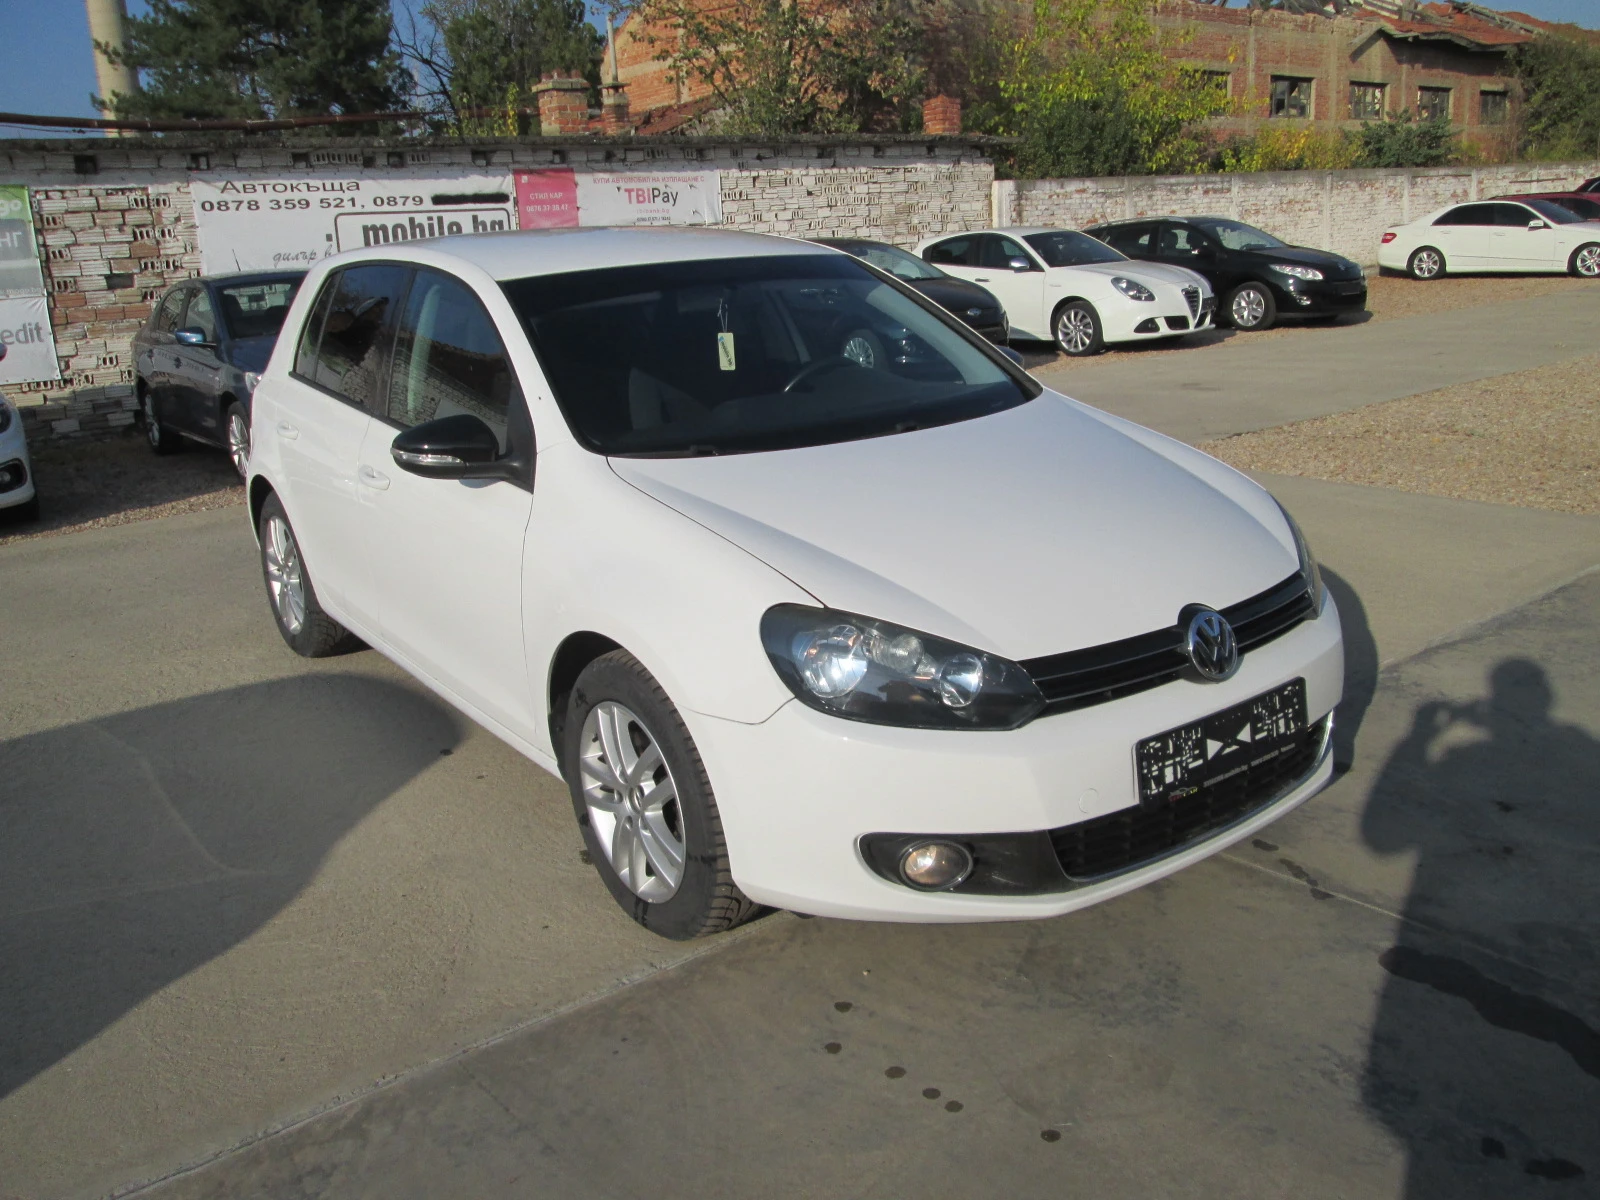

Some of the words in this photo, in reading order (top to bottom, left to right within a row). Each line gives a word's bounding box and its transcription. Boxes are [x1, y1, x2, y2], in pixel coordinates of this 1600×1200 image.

[220, 180, 360, 194] Автокъща
[201, 200, 260, 212] 0878
[269, 198, 310, 210] 359
[319, 197, 365, 209] 521,
[372, 195, 424, 207] 0879
[624, 187, 678, 207] TBIPay
[273, 249, 318, 268] дилър
